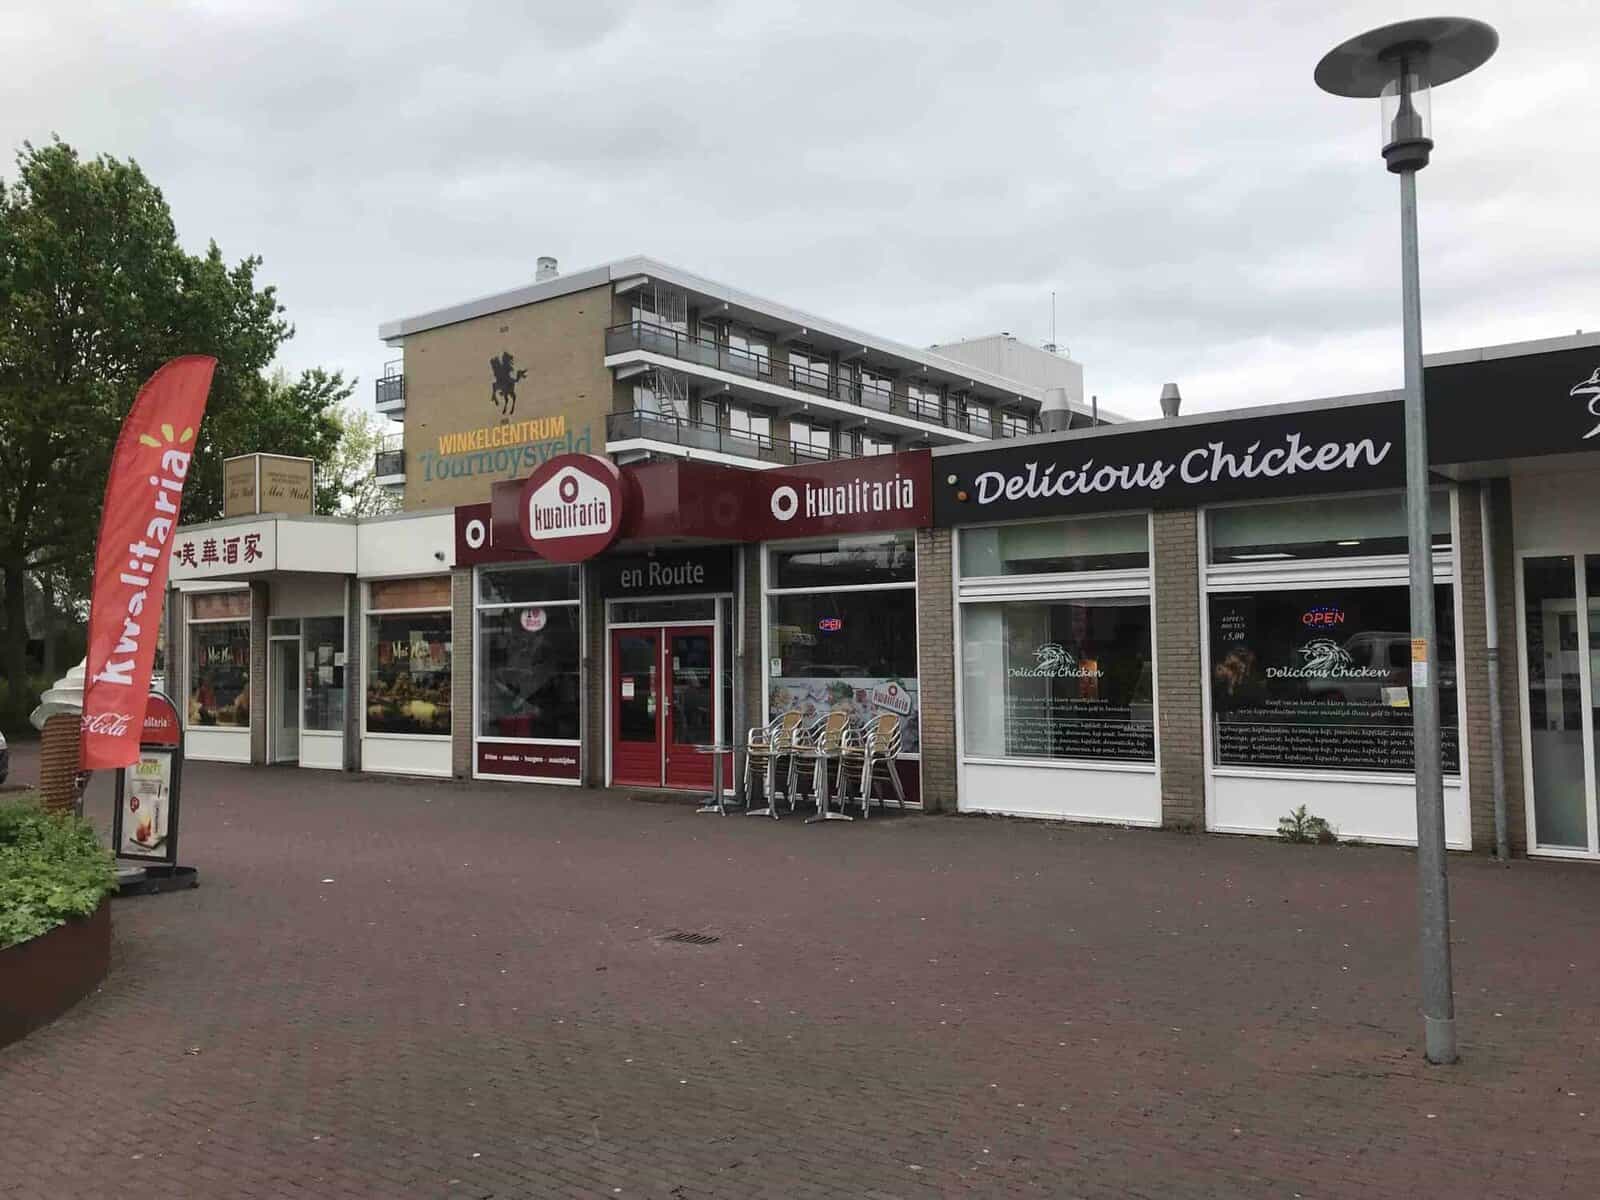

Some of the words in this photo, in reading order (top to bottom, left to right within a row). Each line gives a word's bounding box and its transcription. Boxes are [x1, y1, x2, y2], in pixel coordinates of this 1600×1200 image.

[417, 426, 592, 482] Tournoysveld
[439, 415, 565, 456] WINKELCENTRUM
[974, 459, 1177, 504] Delicious
[1180, 432, 1391, 484] Chicken
[534, 497, 607, 531] kwalitaria
[805, 474, 914, 519] kwalitaria
[620, 570, 643, 588] en
[648, 561, 705, 586] Route
[1302, 611, 1345, 624] OPEN
[1266, 666, 1329, 680] Delicious
[1331, 665, 1391, 679] Chicken
